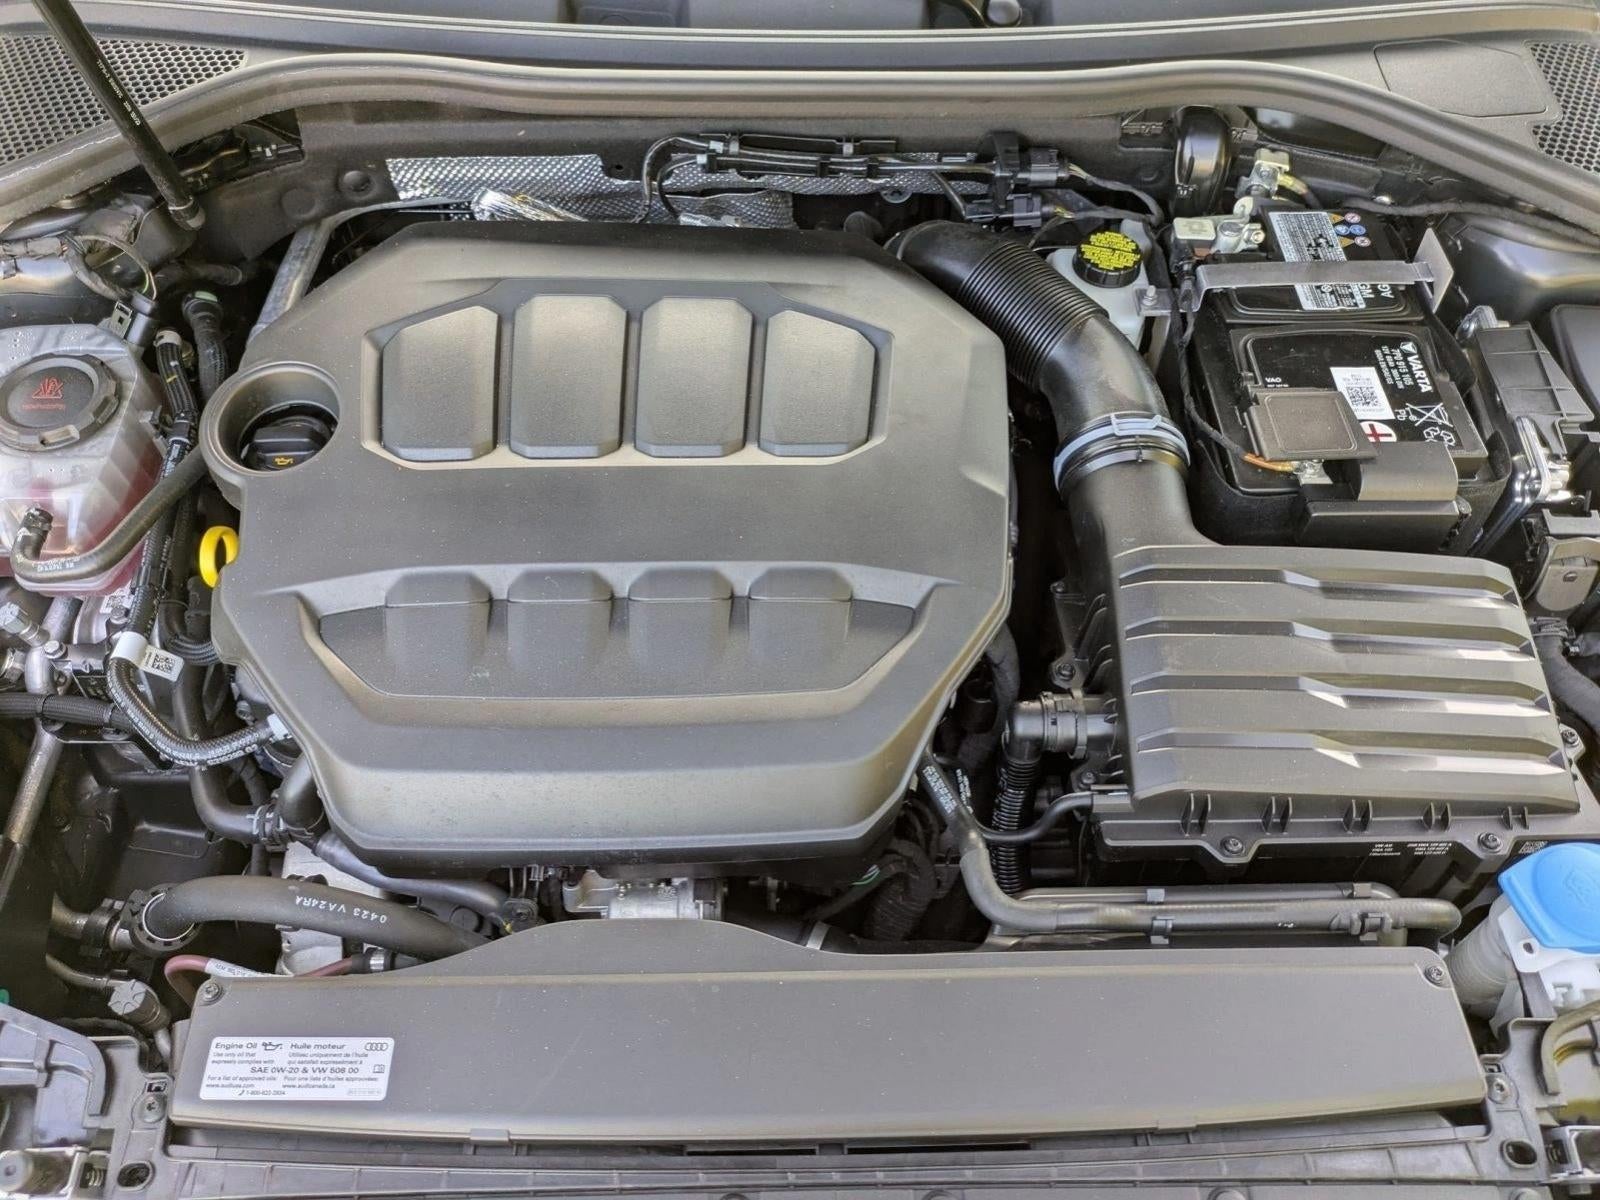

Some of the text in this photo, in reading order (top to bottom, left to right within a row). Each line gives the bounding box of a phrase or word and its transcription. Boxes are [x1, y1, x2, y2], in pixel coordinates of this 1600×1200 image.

[1396, 361, 1409, 373] 915
[1407, 355, 1433, 392] VARTA
[1401, 374, 1414, 385] 105
[1395, 409, 1407, 420] Pb
[353, 907, 387, 924] 0423
[215, 1042, 243, 1050] Engine
